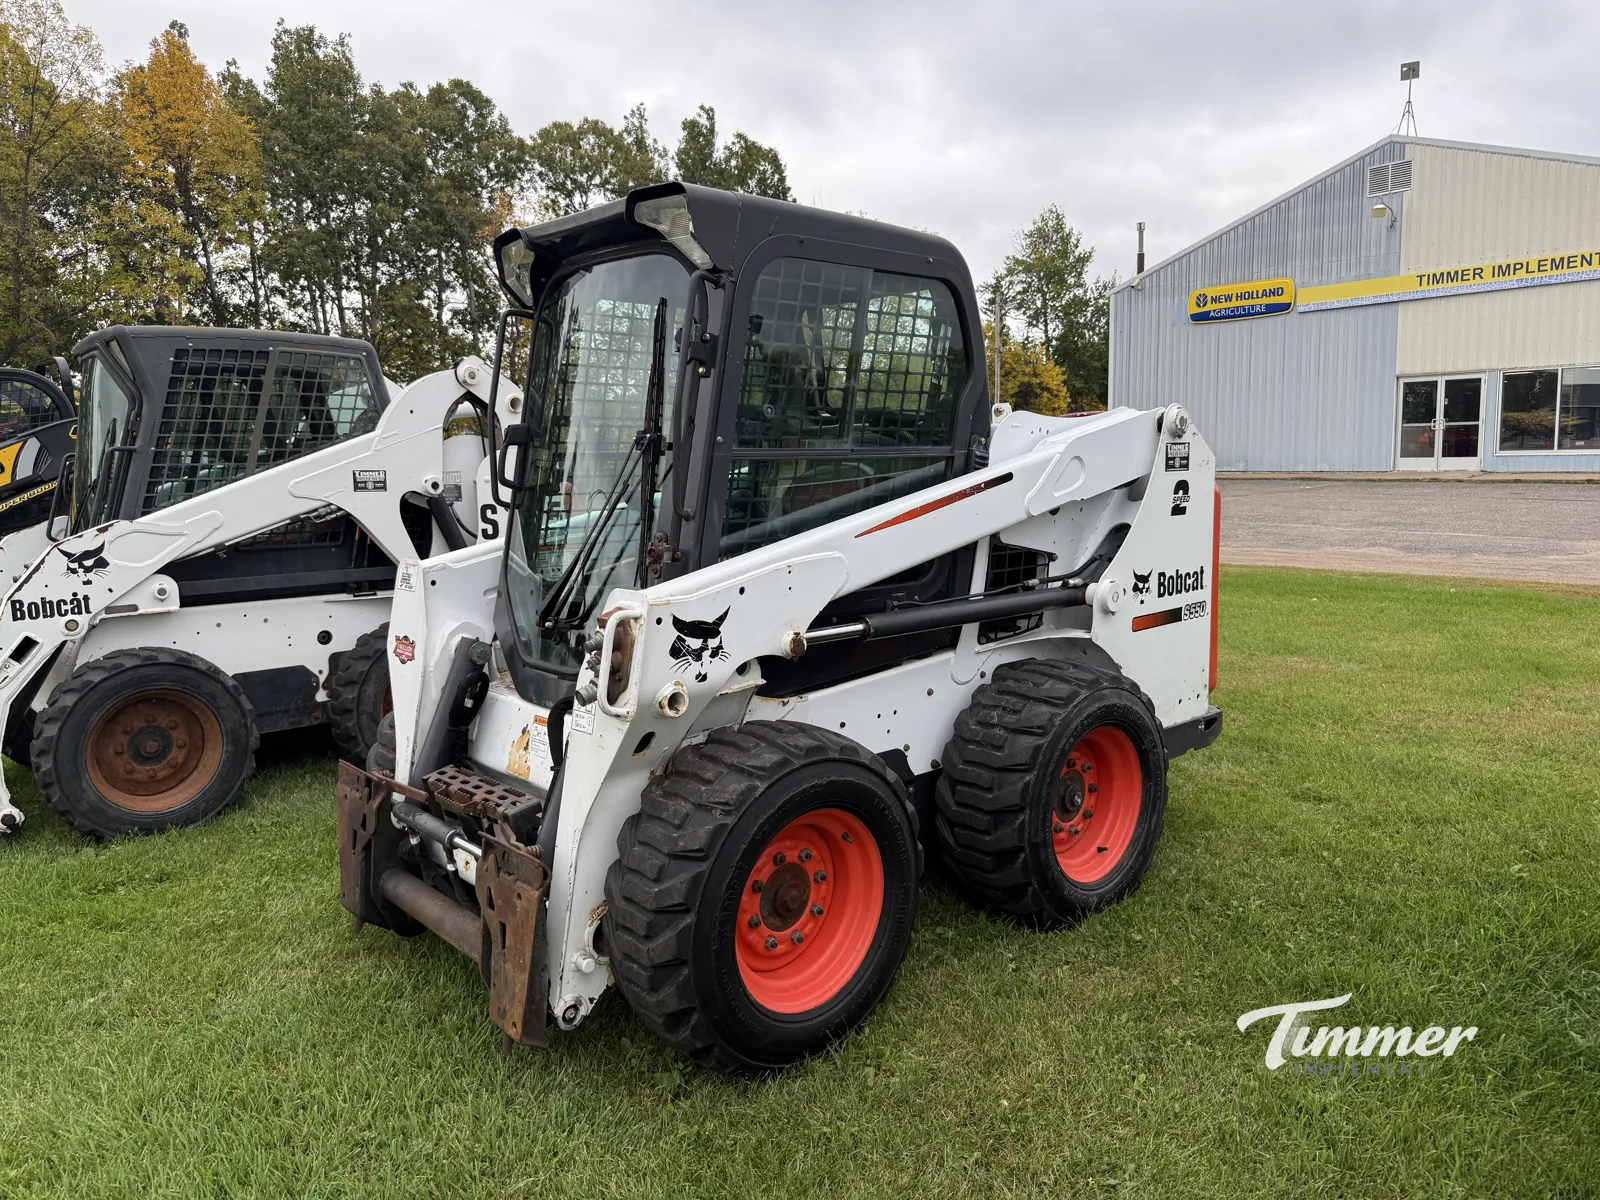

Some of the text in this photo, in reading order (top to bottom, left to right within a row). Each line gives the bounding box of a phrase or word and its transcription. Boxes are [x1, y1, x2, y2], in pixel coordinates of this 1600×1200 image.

[1416, 267, 1484, 287] TIMMER
[1210, 286, 1284, 304] NEW HOLLAND
[1209, 304, 1266, 318] AGRICULTURE
[354, 470, 386, 478] TIMMER
[1172, 495, 1190, 504] SPEED
[1157, 566, 1205, 598] Bobcat
[10, 594, 93, 622] Bobcat
[1183, 600, 1207, 621] S550
